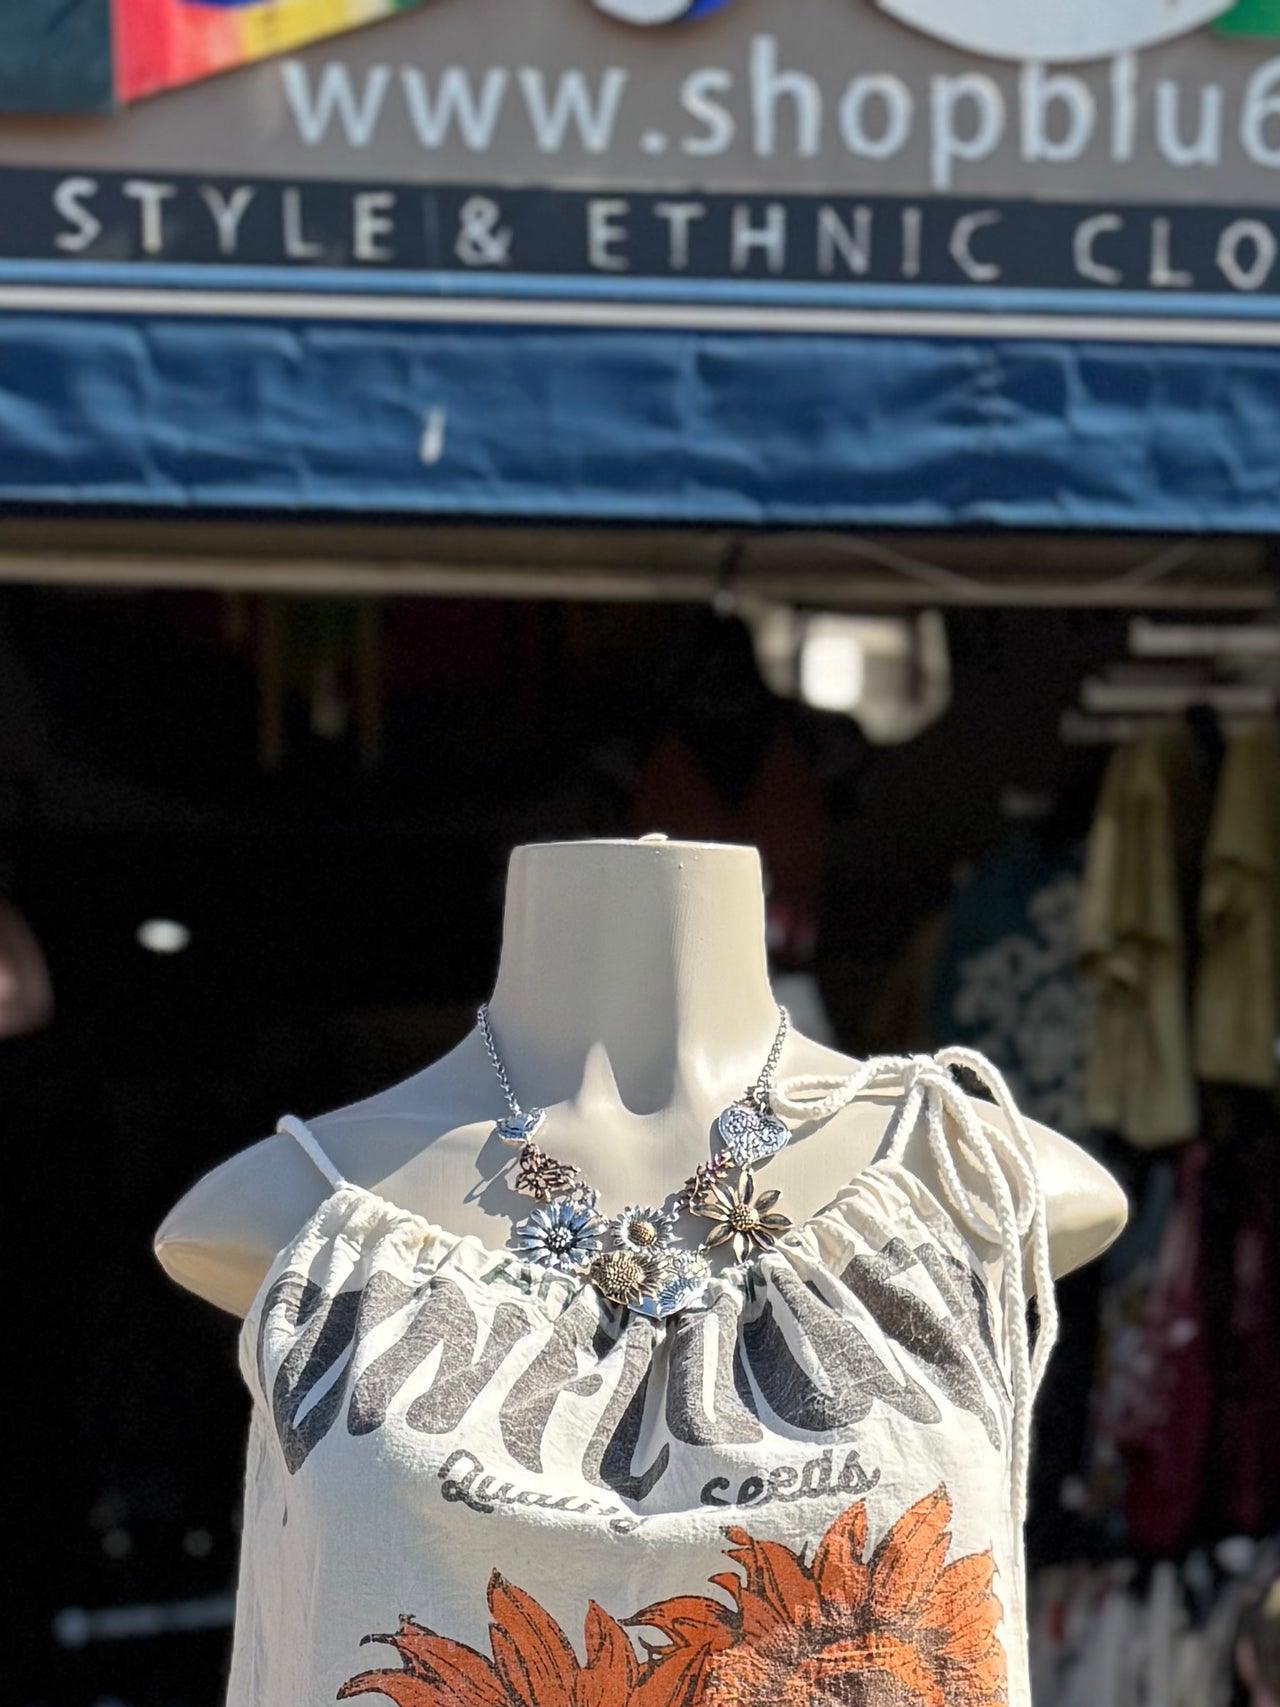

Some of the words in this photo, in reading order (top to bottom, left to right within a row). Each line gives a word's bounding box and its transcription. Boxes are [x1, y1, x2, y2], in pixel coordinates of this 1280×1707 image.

[52, 177, 394, 261] STYLE
[454, 196, 514, 265] &
[588, 199, 1003, 282] ETHNIC
